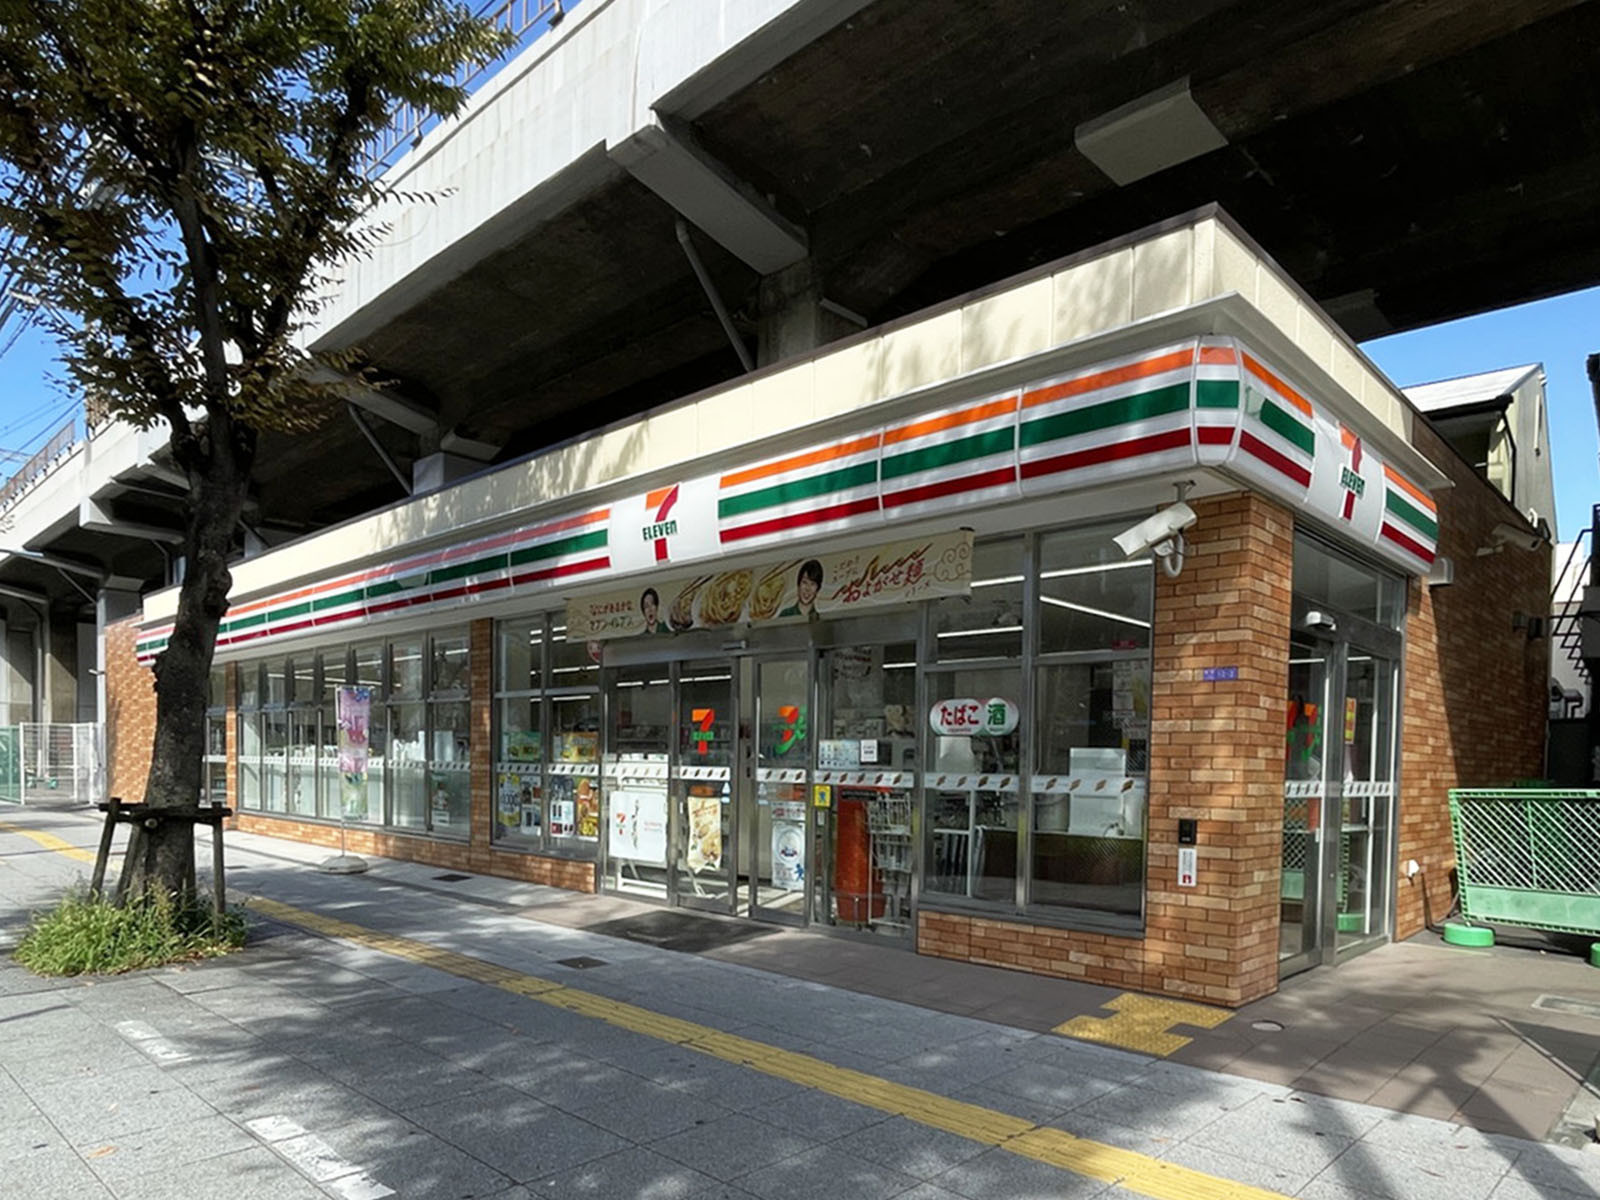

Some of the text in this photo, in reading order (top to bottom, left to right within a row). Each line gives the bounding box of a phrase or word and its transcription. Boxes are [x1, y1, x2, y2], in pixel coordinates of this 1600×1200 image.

[645, 483, 680, 561] 7
[940, 704, 1006, 726] たばこ 酒
